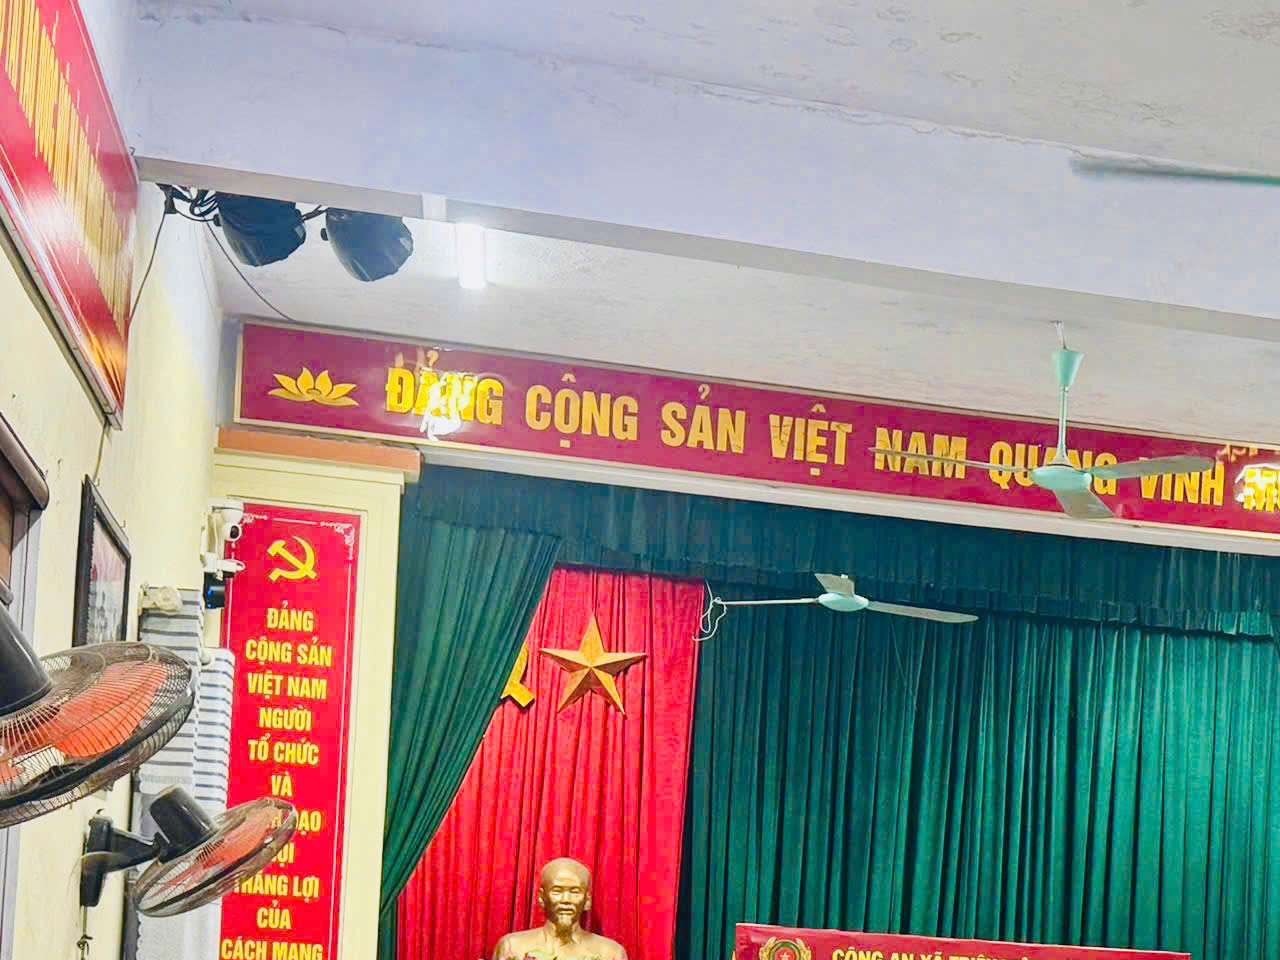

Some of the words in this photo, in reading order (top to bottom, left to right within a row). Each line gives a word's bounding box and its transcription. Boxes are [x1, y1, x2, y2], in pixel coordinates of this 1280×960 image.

[525, 373, 639, 448] CỘNG
[660, 383, 746, 453] SẢN
[769, 404, 852, 476] VIỆT
[875, 427, 967, 480] NAM
[267, 600, 314, 632] ĐẢNG
[245, 637, 292, 666] CỘNG
[297, 637, 332, 667] SẢN
[247, 670, 283, 700] VIỆT
[287, 676, 327, 700] NAM
[259, 705, 312, 731] NGƯỜI
[248, 733, 270, 761] TỔ
[274, 738, 319, 766] CHỨC
[271, 771, 292, 797] VÀ
[291, 810, 322, 836] ẠO
[293, 875, 319, 902] LỢI
[256, 900, 291, 930] CỦA
[221, 936, 267, 960] CÁCH
